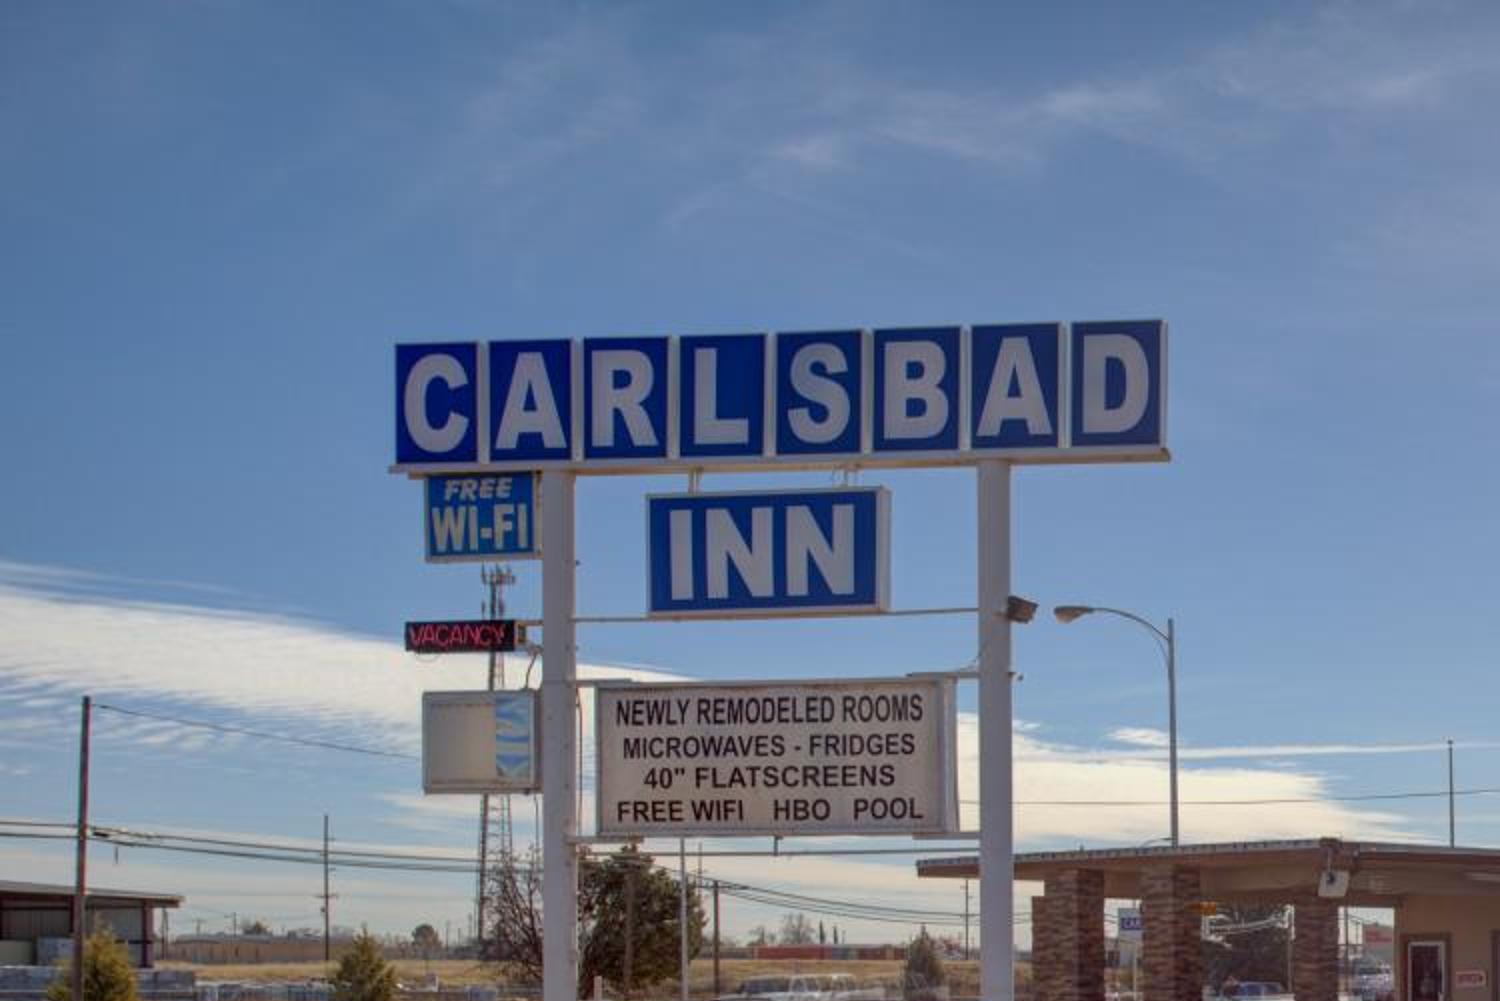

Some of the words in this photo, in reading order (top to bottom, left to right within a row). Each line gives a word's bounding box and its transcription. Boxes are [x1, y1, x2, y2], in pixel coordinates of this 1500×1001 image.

[403, 332, 1150, 453] CARLSBAD
[444, 477, 513, 501] FREE
[431, 503, 528, 551] WI-FI
[669, 503, 855, 600] INN
[409, 622, 506, 647] VACANCY
[616, 698, 689, 727] NEWLY
[697, 696, 835, 726] REMODELED
[843, 693, 923, 723] ROOMS
[623, 734, 785, 760] MICROWAVES
[809, 733, 915, 757] FRIDGES
[643, 766, 685, 790] 40"
[695, 765, 896, 790] FLATSCREENS
[616, 800, 684, 823] FREE
[691, 799, 744, 822] WIFI
[773, 799, 831, 821] HBO
[853, 797, 924, 820] POOL
